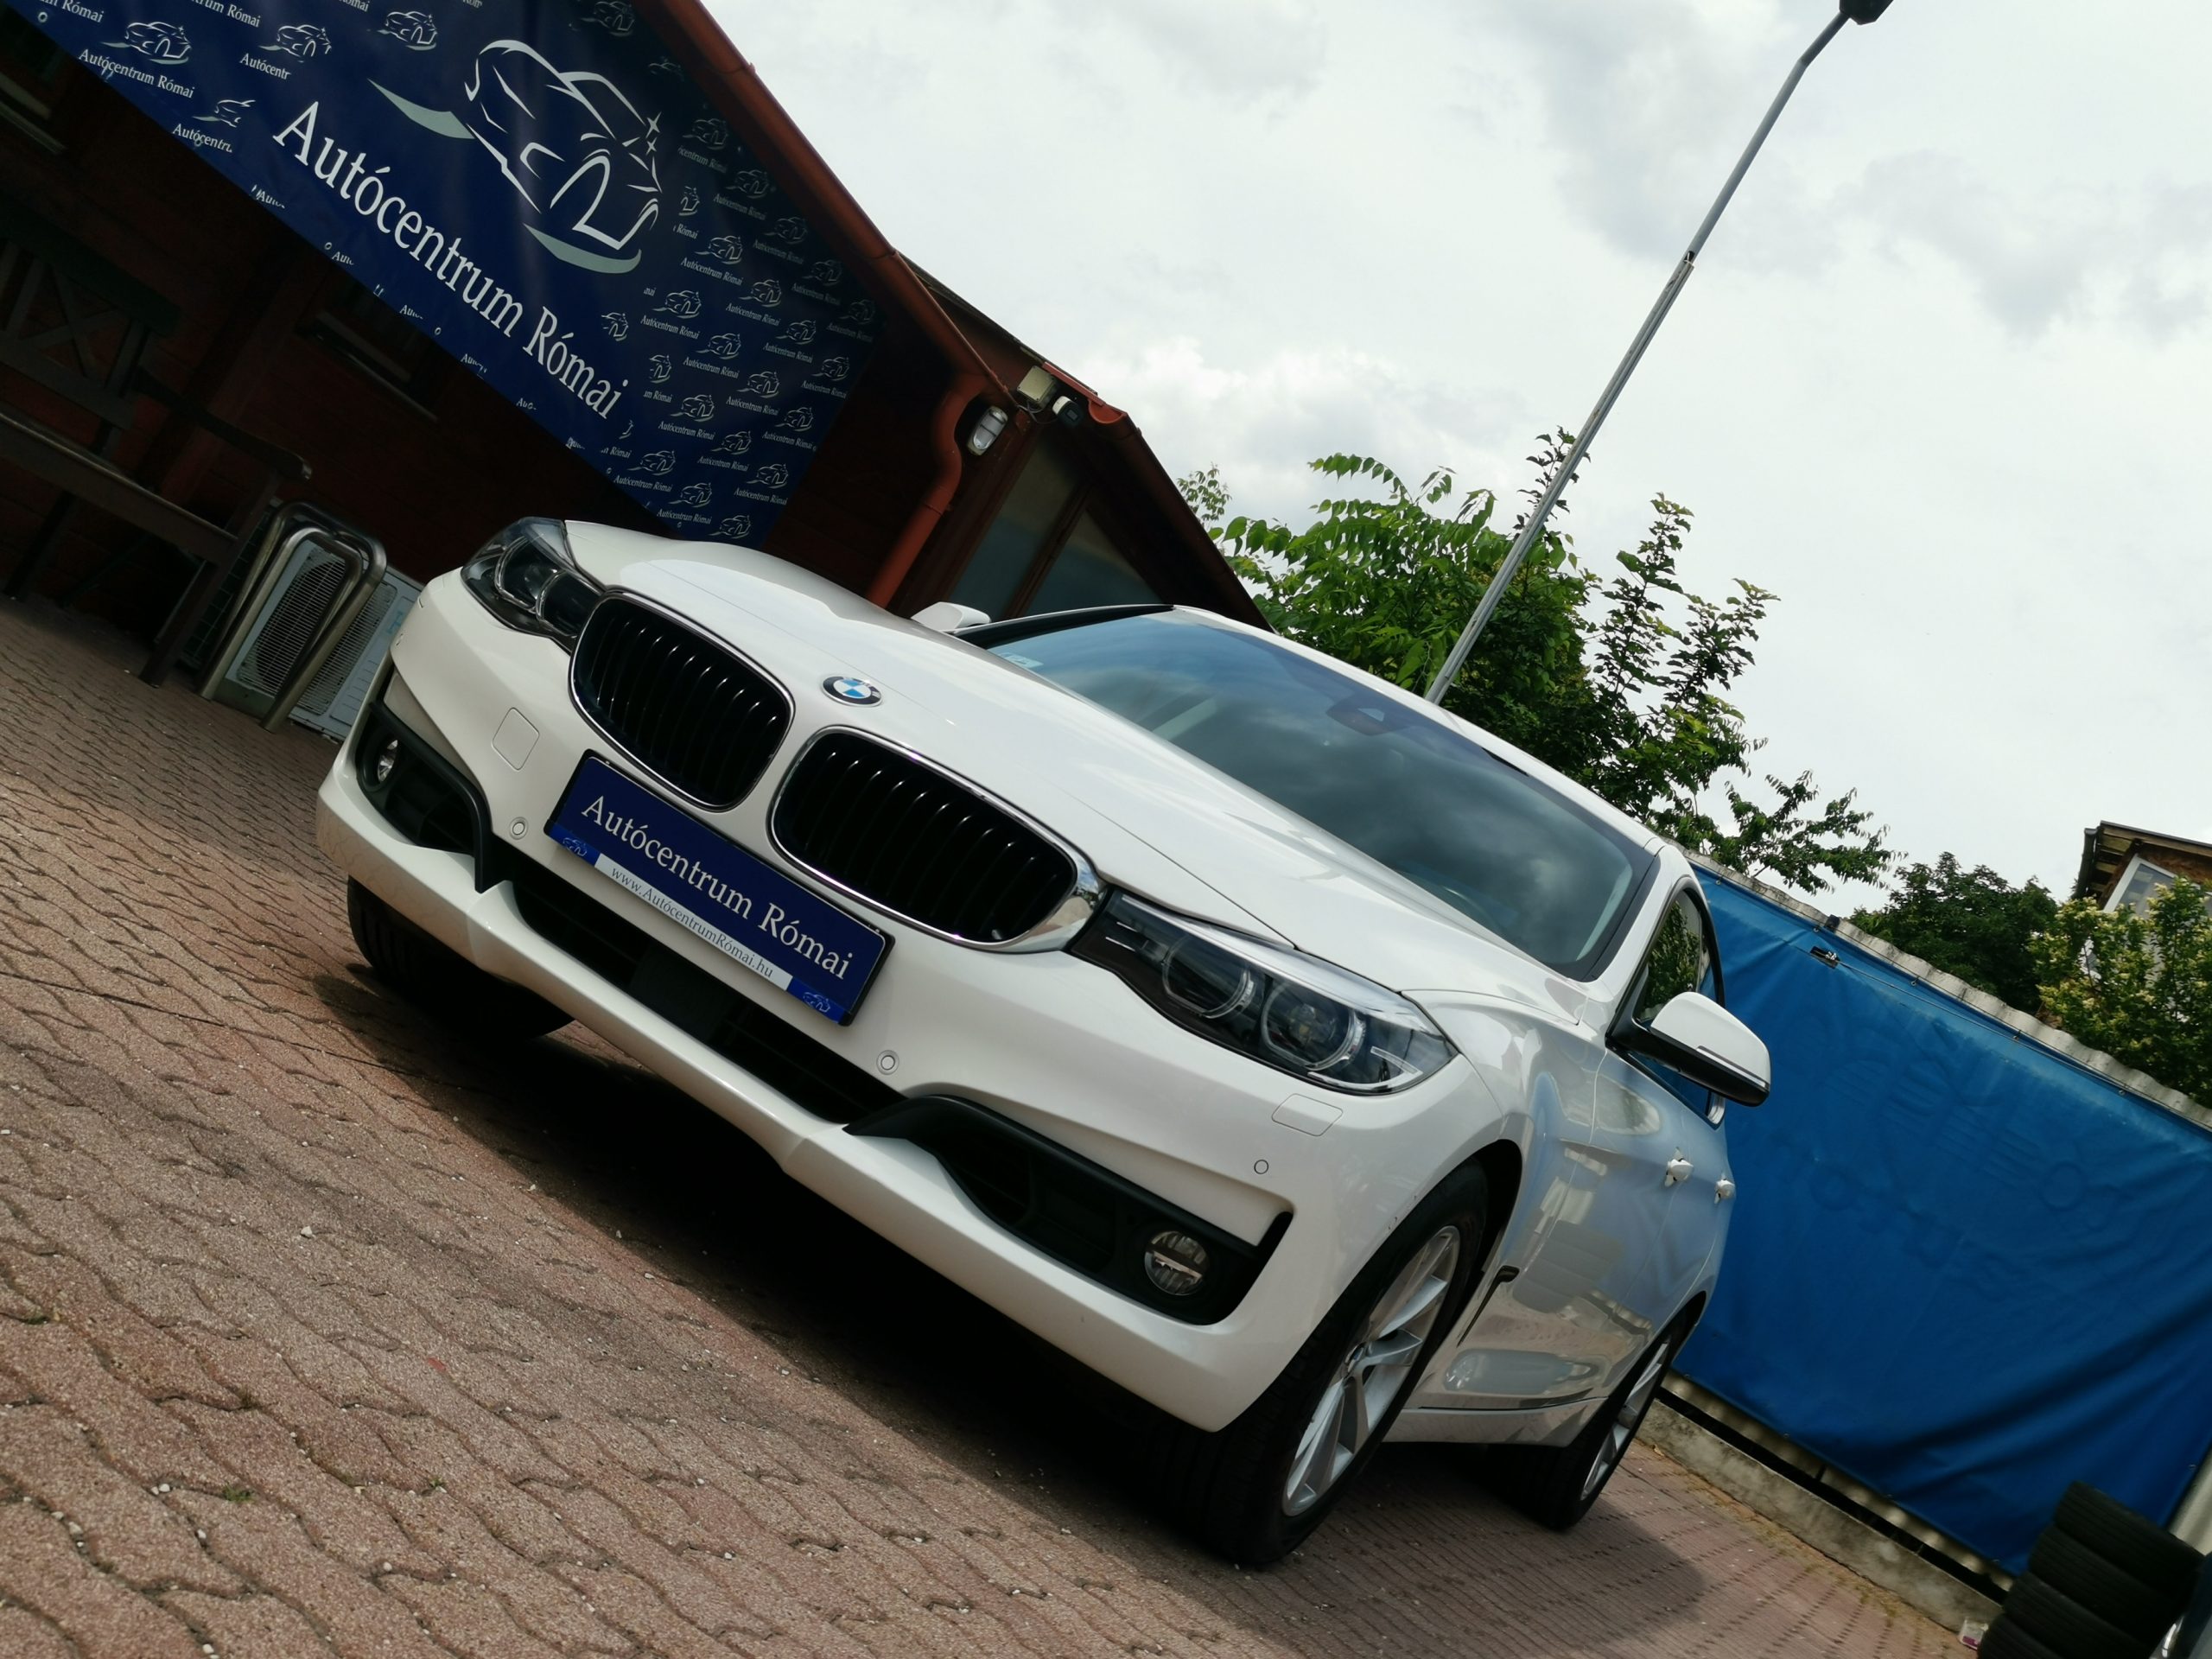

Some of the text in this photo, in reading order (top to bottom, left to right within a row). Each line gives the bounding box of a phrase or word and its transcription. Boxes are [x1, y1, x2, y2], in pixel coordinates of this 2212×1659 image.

[62, 0, 105, 22] Római
[227, 4, 261, 28] Római
[79, 49, 195, 99] Autócentrum Római
[272, 100, 629, 420] Autócentrum Római
[680, 257, 722, 279] Autócentrum
[640, 315, 678, 334] Autócentrum
[582, 795, 854, 980] Autócentrum Római
[611, 867, 773, 978] www.AutócentrumRómai.hu
